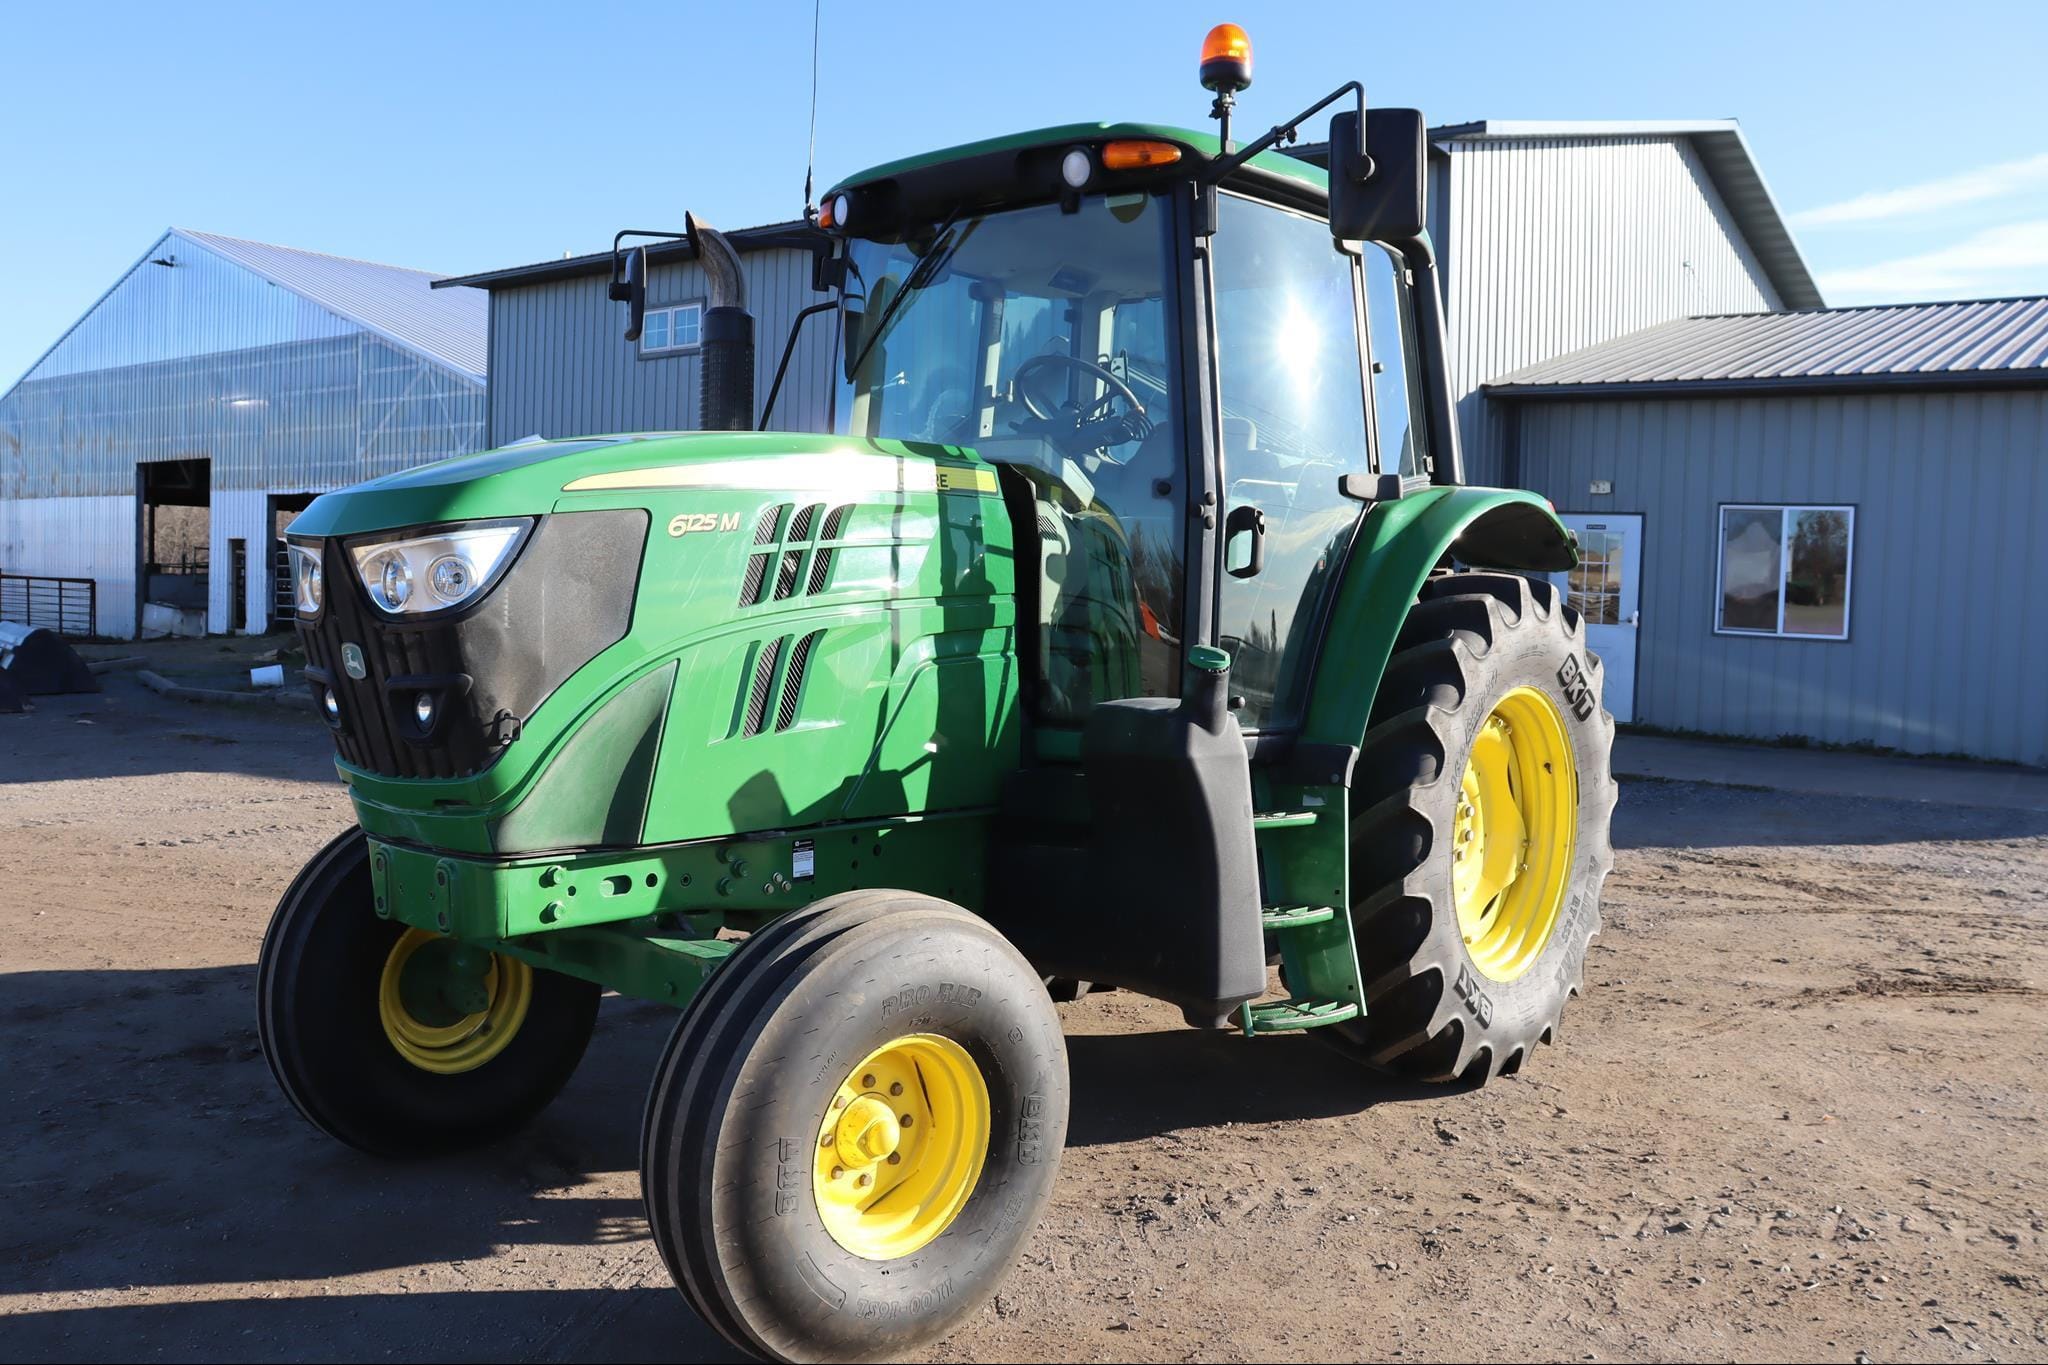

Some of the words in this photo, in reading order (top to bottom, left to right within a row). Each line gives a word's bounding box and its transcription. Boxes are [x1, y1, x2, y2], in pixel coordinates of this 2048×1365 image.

[1558, 654, 1595, 721] BKT
[1455, 965, 1493, 1029] BKT
[1018, 1095, 1046, 1166] BKT
[776, 1137, 803, 1216] BKT
